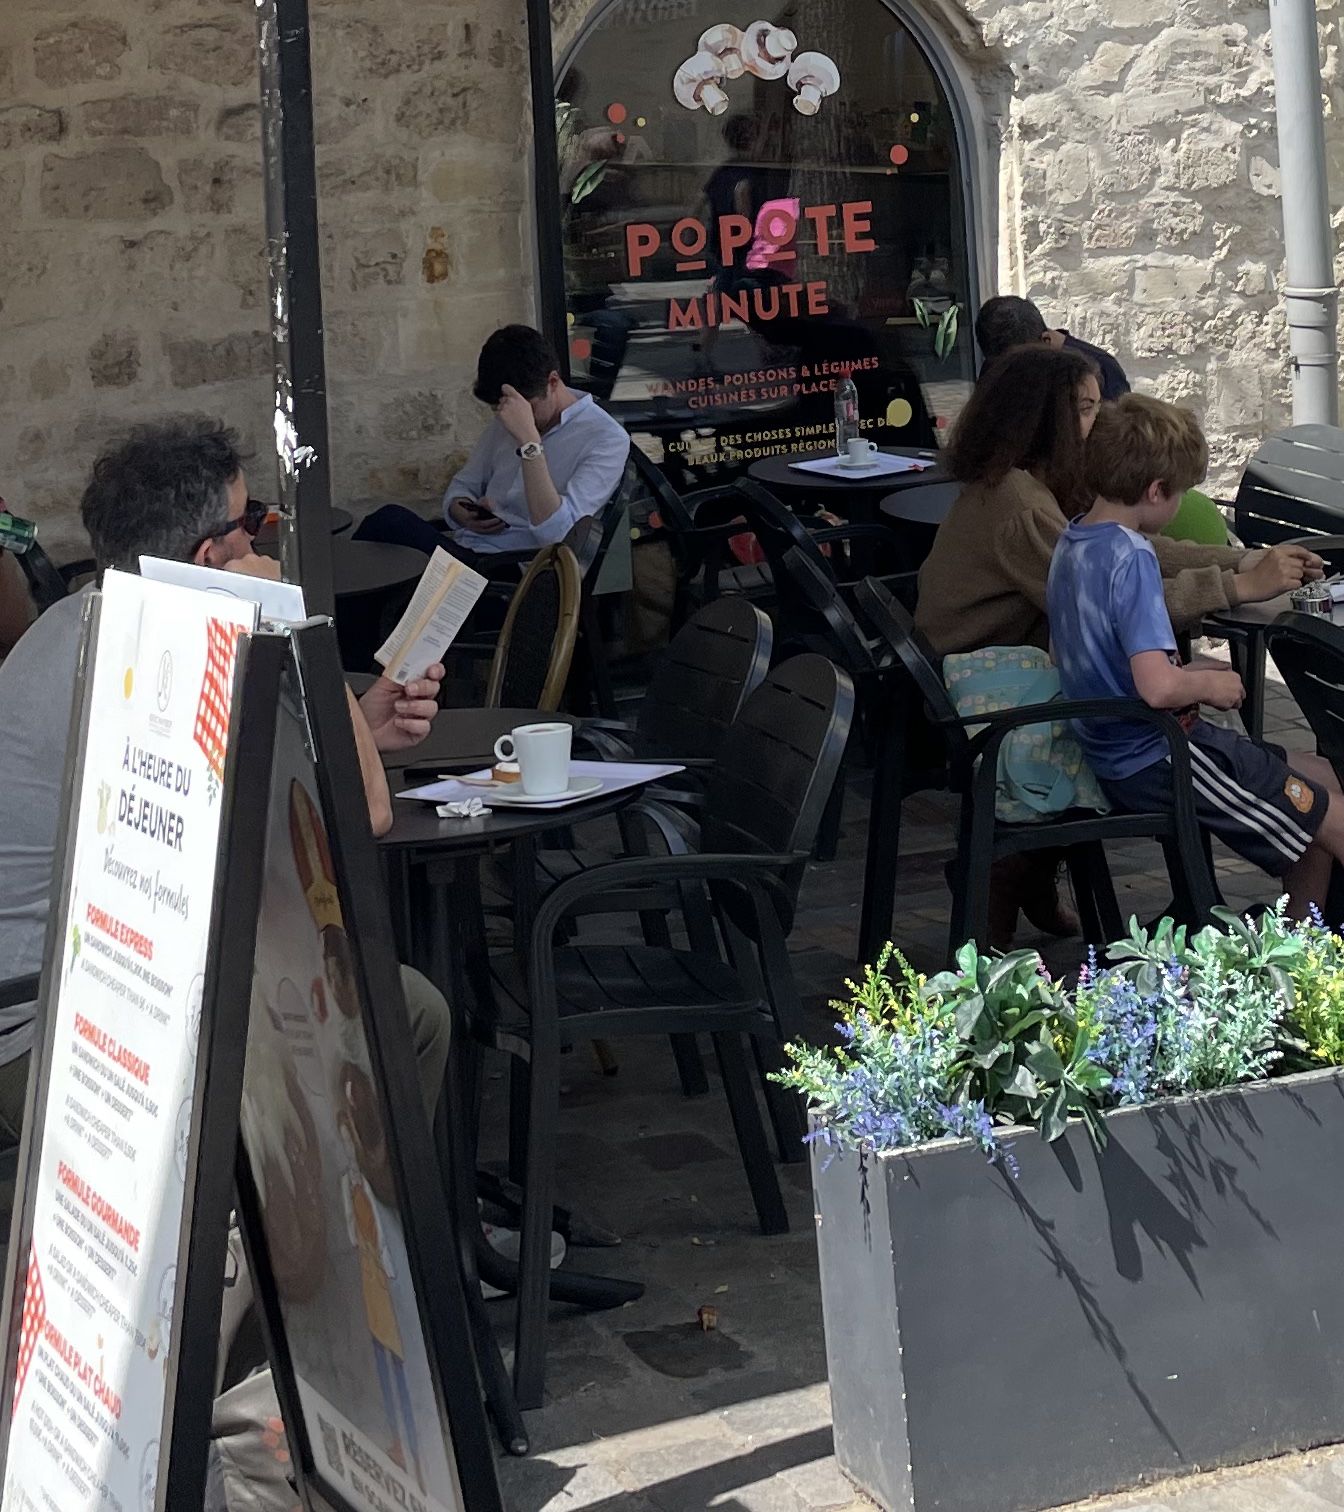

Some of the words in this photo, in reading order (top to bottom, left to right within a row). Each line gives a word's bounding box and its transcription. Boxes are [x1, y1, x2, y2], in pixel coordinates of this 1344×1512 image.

[626, 200, 877, 277] POPOTE
[668, 280, 829, 331] MINUTE
[688, 386, 756, 410] CUISINÉS
[761, 383, 788, 400] SUR
[793, 377, 837, 396] PLACE
[723, 368, 797, 387] POISSONS
[801, 365, 811, 377] &
[814, 356, 880, 376] LÉGUMES
[720, 433, 742, 447] DES
[745, 428, 792, 444] CHOSES
[795, 422, 838, 438] SIMPLE
[729, 444, 788, 461] PRODUITS
[122, 735, 131, 772] À
[131, 745, 174, 790] L'HEURE
[175, 764, 192, 797] DU
[118, 783, 184, 852] DÉJEUNER
[86, 903, 120, 940] FORMULE
[119, 923, 154, 961] EXPRESS
[74, 1012, 107, 1054] FORMULE
[108, 1037, 151, 1086] CLASSIQUE
[58, 1160, 91, 1207] FORMULE
[91, 1191, 141, 1253] GOURMANDE
[93, 1372, 122, 1420] CHAUD
